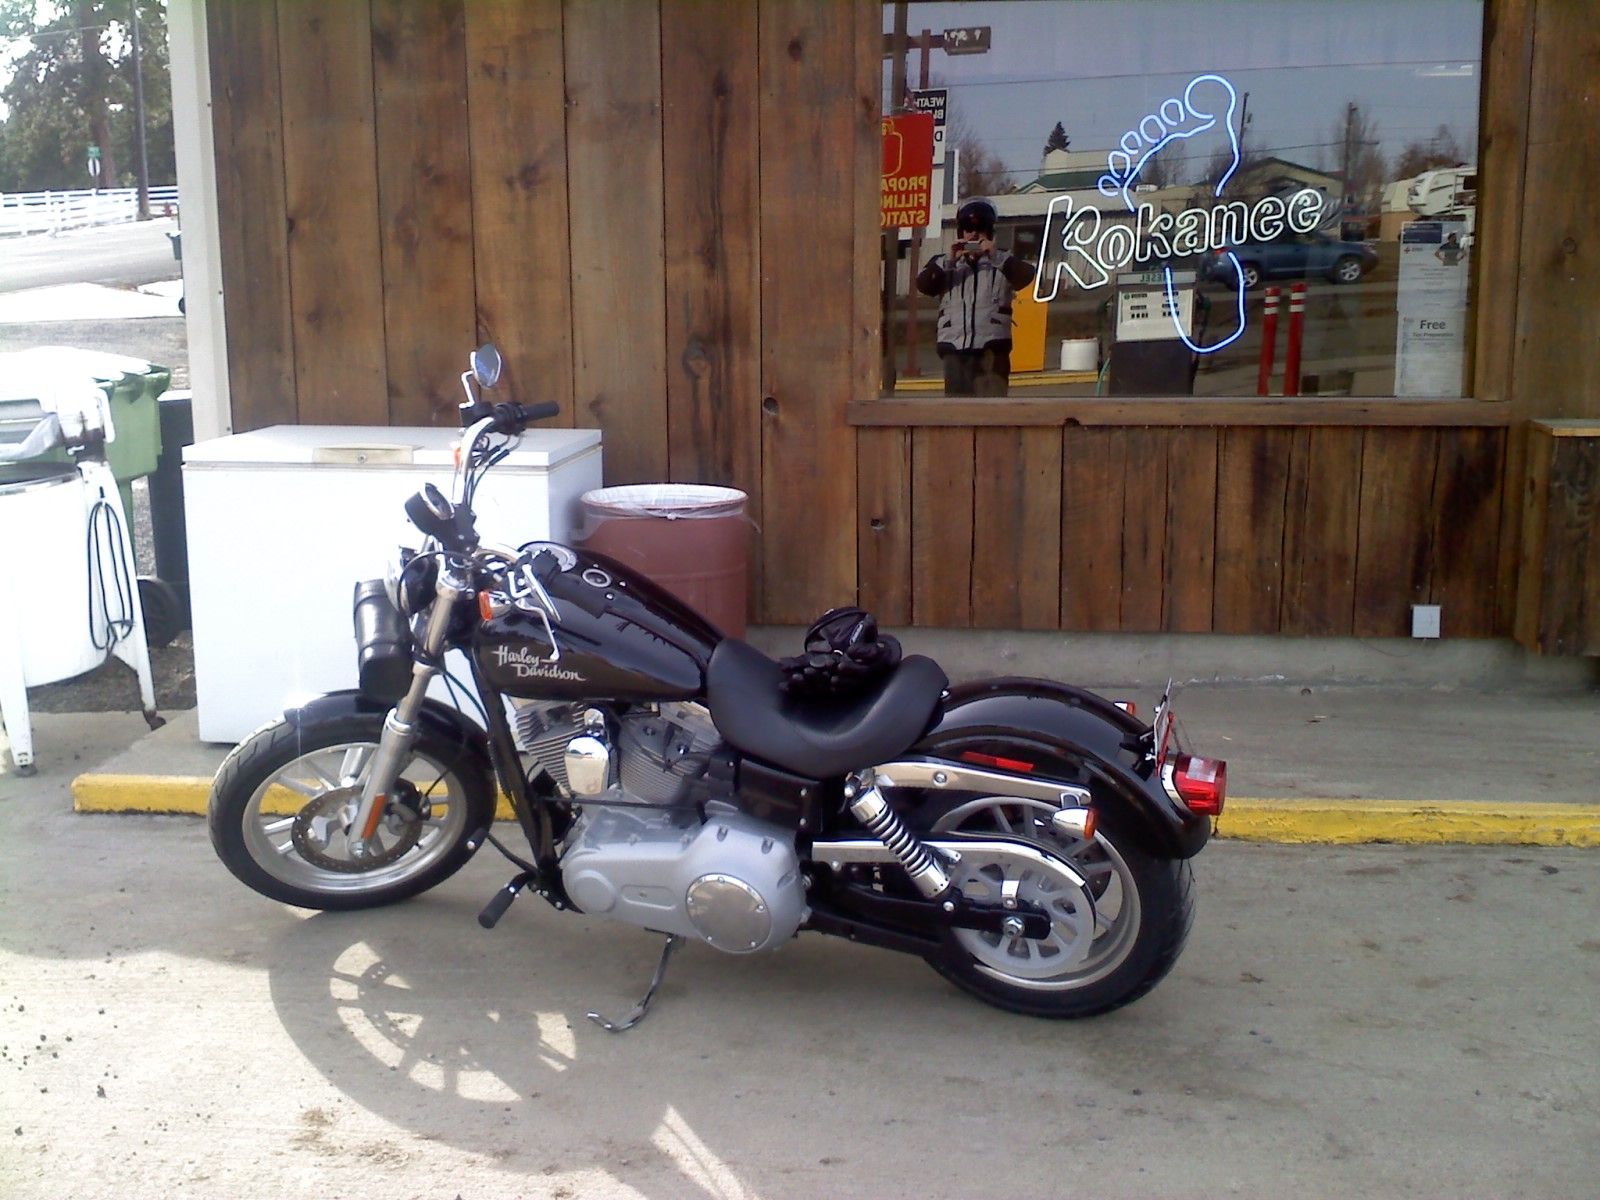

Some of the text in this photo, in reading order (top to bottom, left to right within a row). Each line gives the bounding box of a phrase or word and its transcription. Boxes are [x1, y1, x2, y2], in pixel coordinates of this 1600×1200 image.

[1033, 188, 1323, 303] Kokanee
[1420, 319, 1446, 330] Free
[510, 663, 587, 682] Davidson
